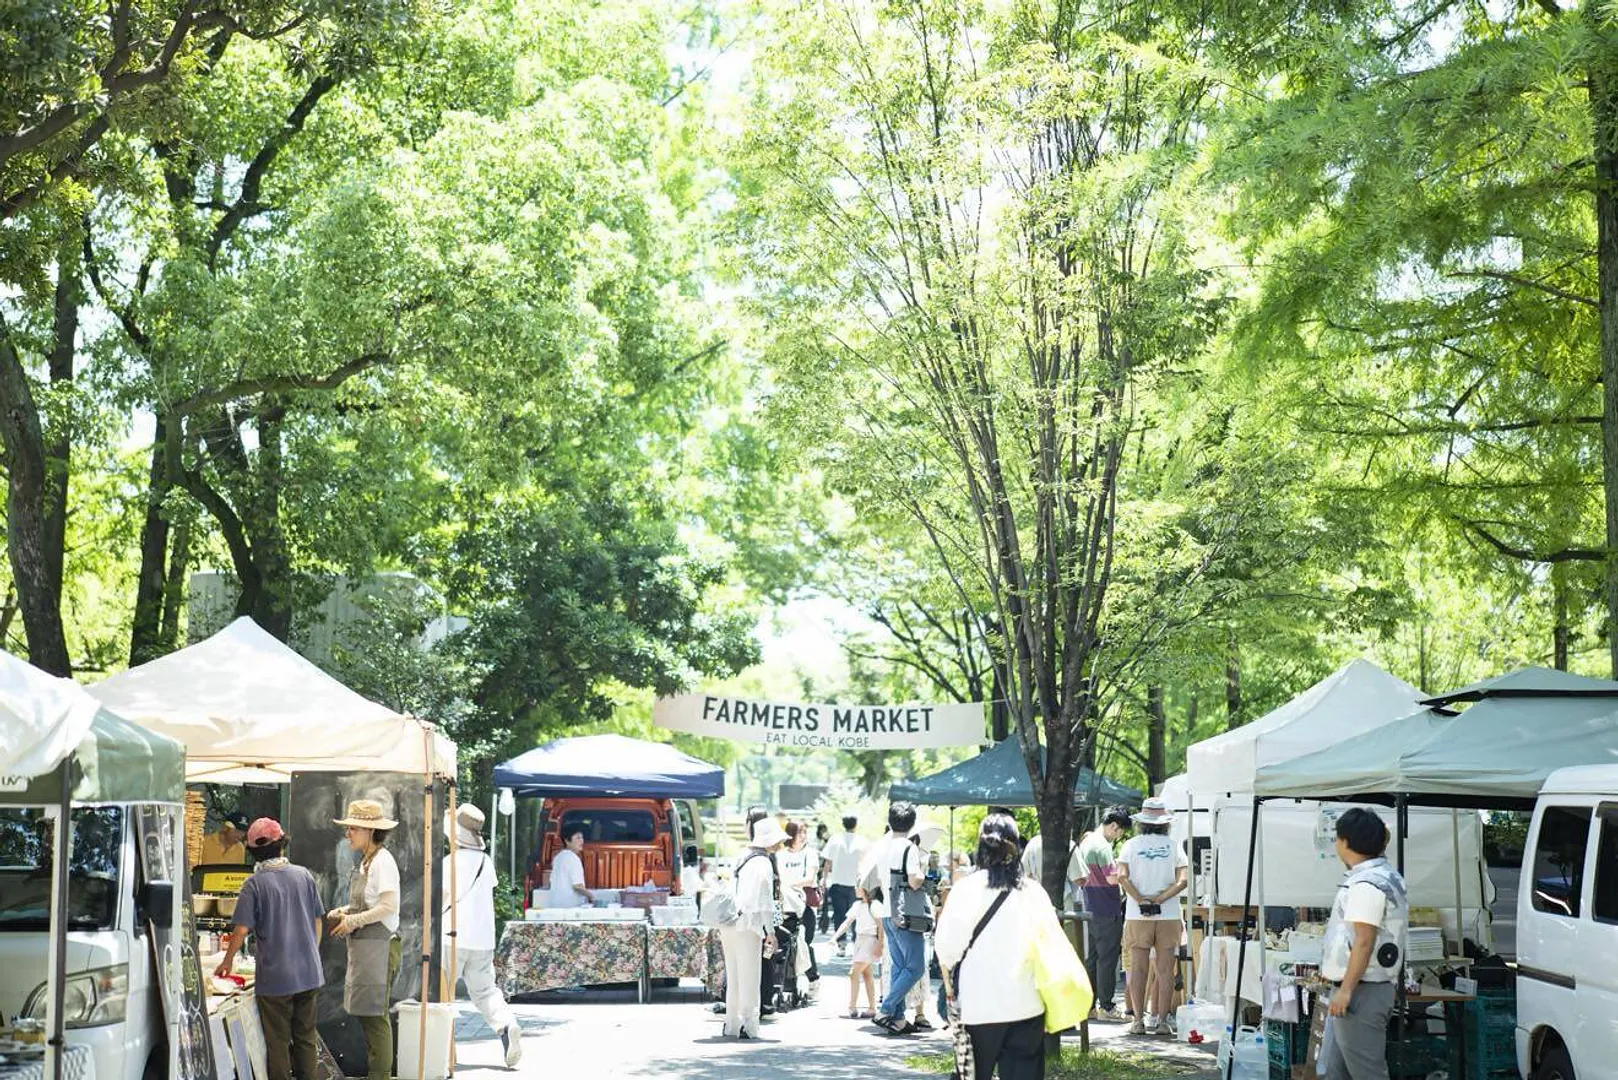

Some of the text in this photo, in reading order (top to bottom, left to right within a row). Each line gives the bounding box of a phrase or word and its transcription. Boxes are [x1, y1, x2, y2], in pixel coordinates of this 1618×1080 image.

[702, 696, 934, 733] FARMERS MARKET
[766, 732, 870, 747] EAT LOCAL KOBE
